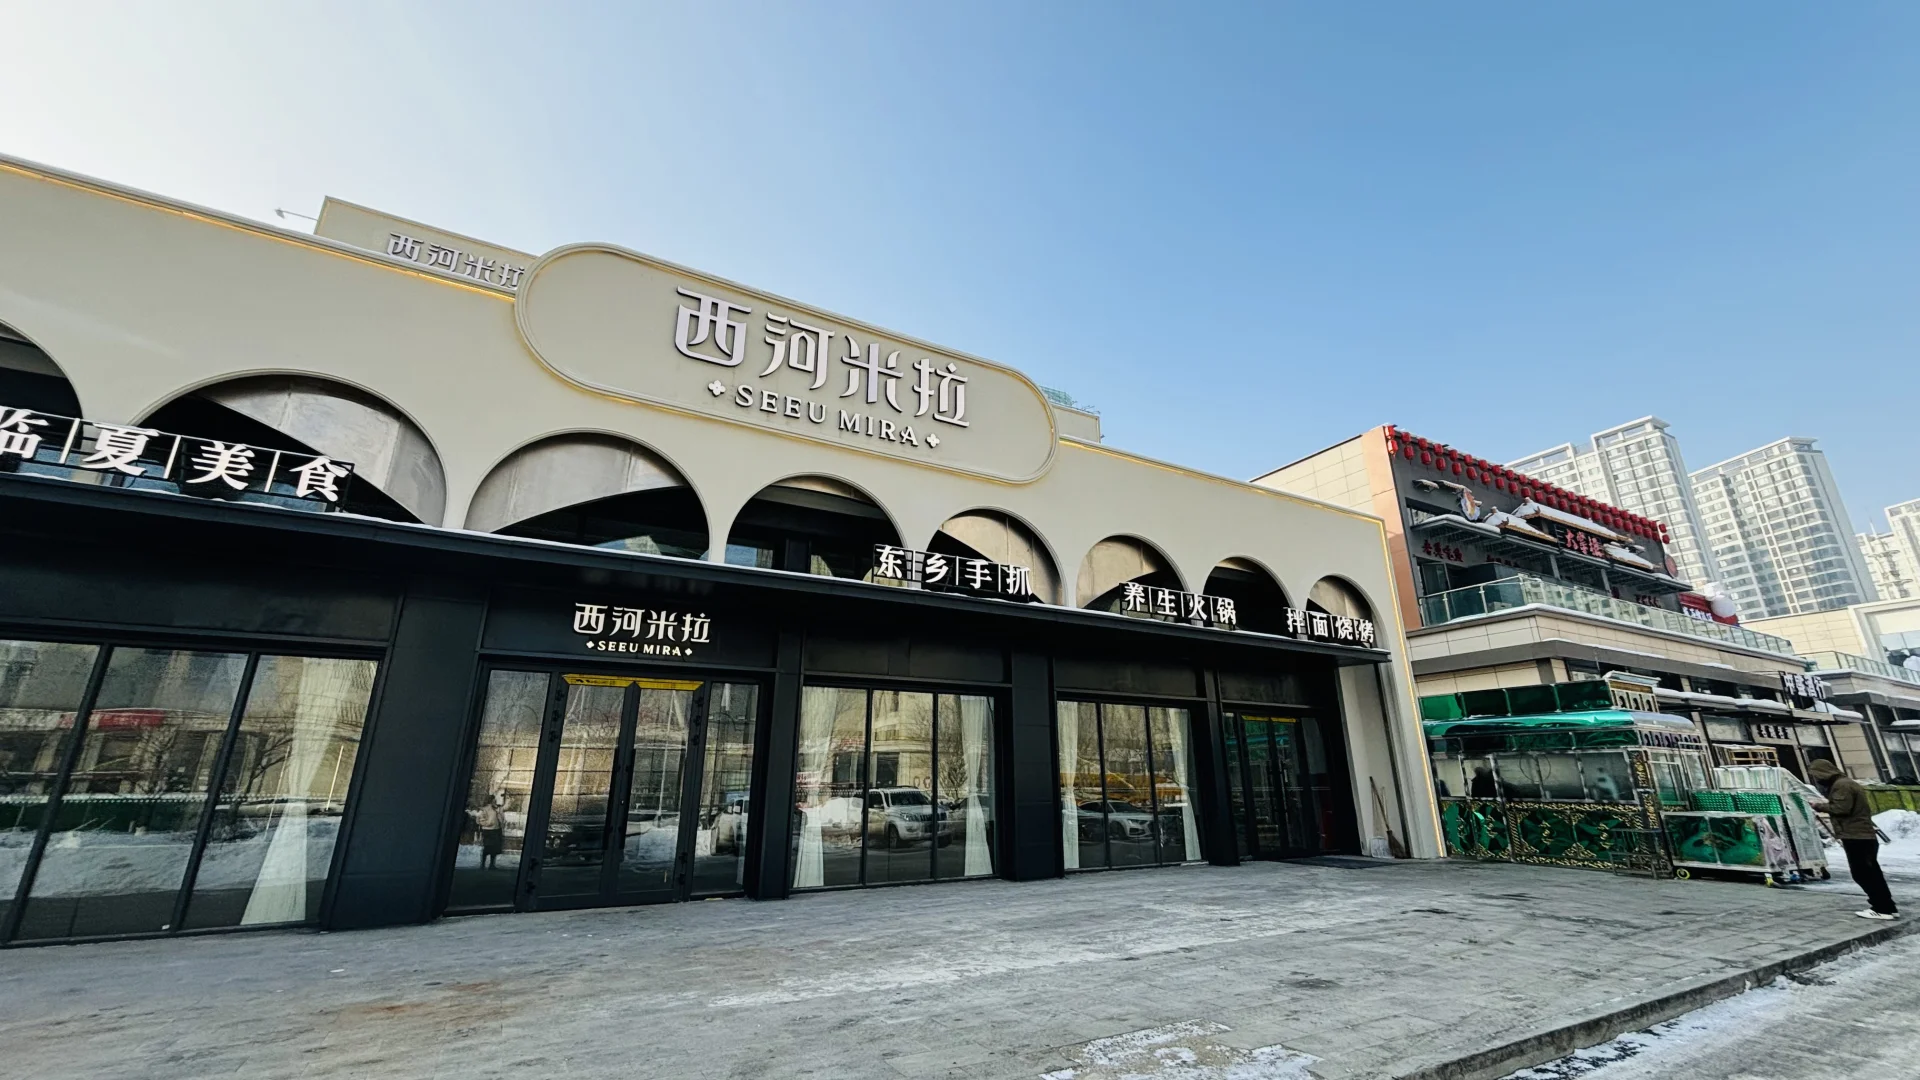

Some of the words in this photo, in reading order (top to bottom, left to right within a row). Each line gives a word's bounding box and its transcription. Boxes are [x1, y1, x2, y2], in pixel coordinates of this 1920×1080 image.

[674, 286, 970, 427] 西河米拉
[734, 383, 827, 424] SEEU
[838, 408, 919, 447] MIRA
[876, 545, 1033, 596] 东乡手抓
[573, 602, 711, 643] 西河米拉
[1123, 583, 1237, 626] 养生火锅
[1286, 607, 1374, 643] 拌面烧烤
[597, 640, 639, 653] SEEU
[643, 644, 682, 657] MIRA
